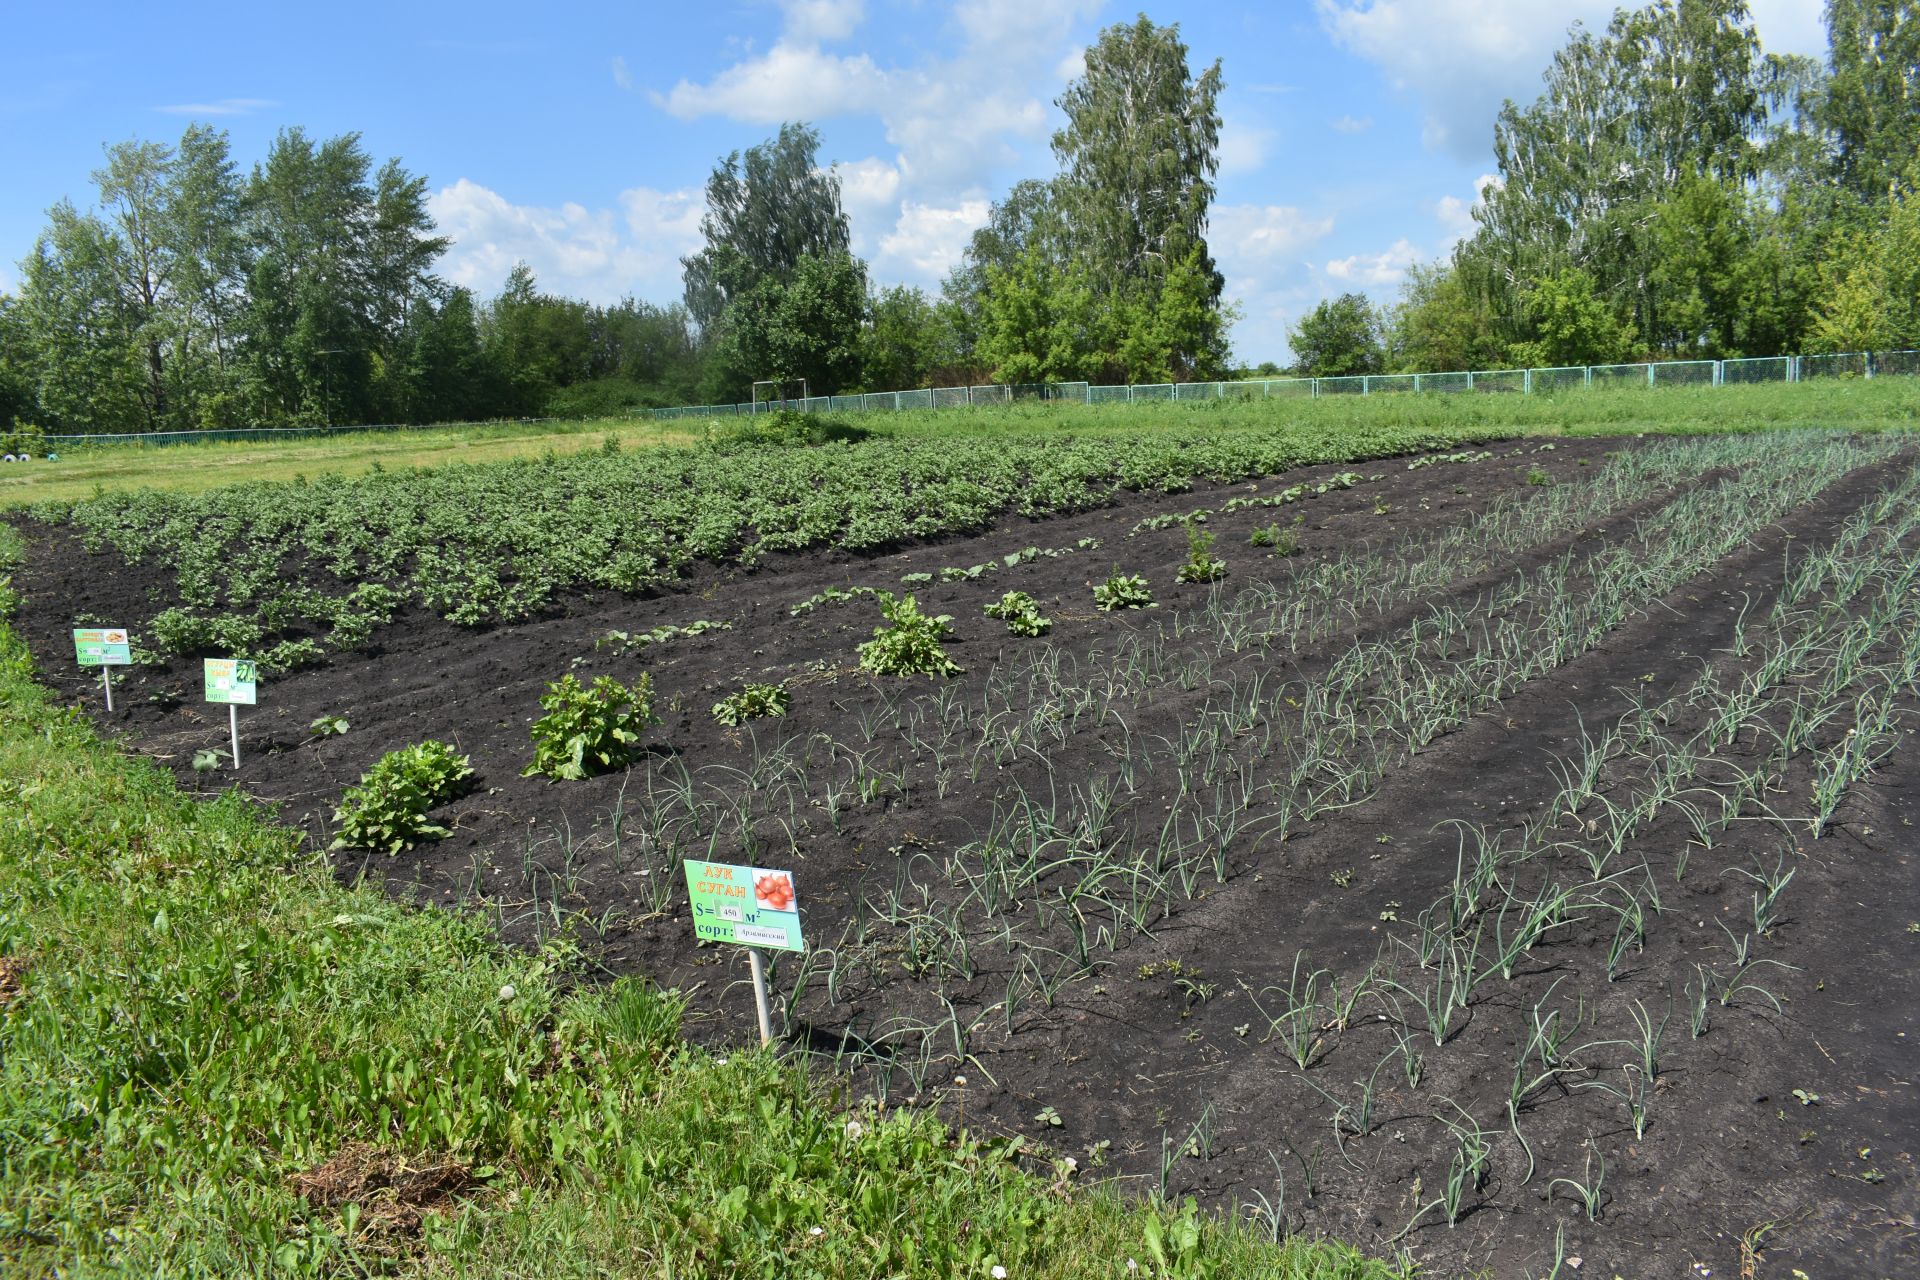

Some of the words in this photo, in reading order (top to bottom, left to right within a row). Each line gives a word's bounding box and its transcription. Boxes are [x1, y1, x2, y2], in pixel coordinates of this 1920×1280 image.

[704, 865, 733, 880] ЛУК
[696, 881, 746, 898] СУГАН
[696, 903, 714, 916] S=
[724, 908, 737, 917] 450
[698, 924, 734, 937] сорт:
